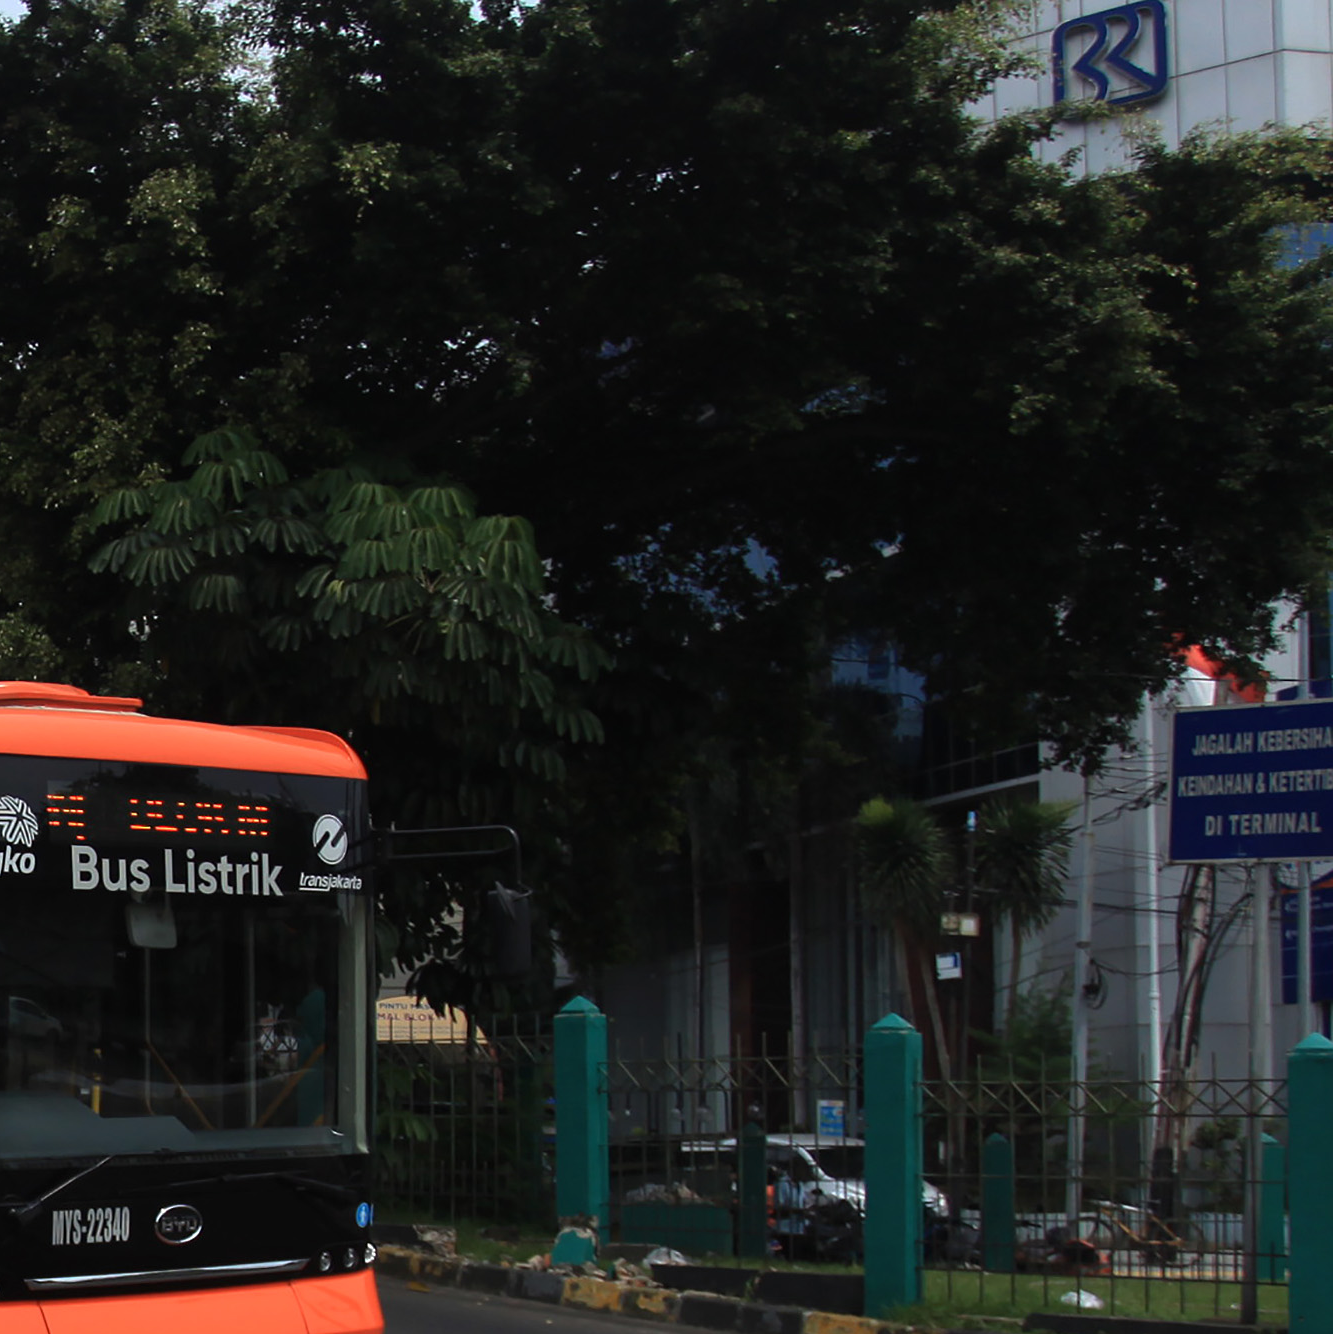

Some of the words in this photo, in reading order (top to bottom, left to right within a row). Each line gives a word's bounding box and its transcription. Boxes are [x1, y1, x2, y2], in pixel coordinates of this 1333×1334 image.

[1192, 731, 1254, 756] JAGALAH
[1177, 773, 1253, 797] KEINDAHAN
[1255, 772, 1265, 794] &
[1204, 815, 1222, 836] DI
[1228, 811, 1322, 835] TERMINAL
[71, 845, 151, 892] Bus
[164, 849, 283, 896] Listrik
[299, 872, 362, 892] transjakarta
[52, 1206, 131, 1245] MYS-22340
[161, 1216, 198, 1233] BYD
